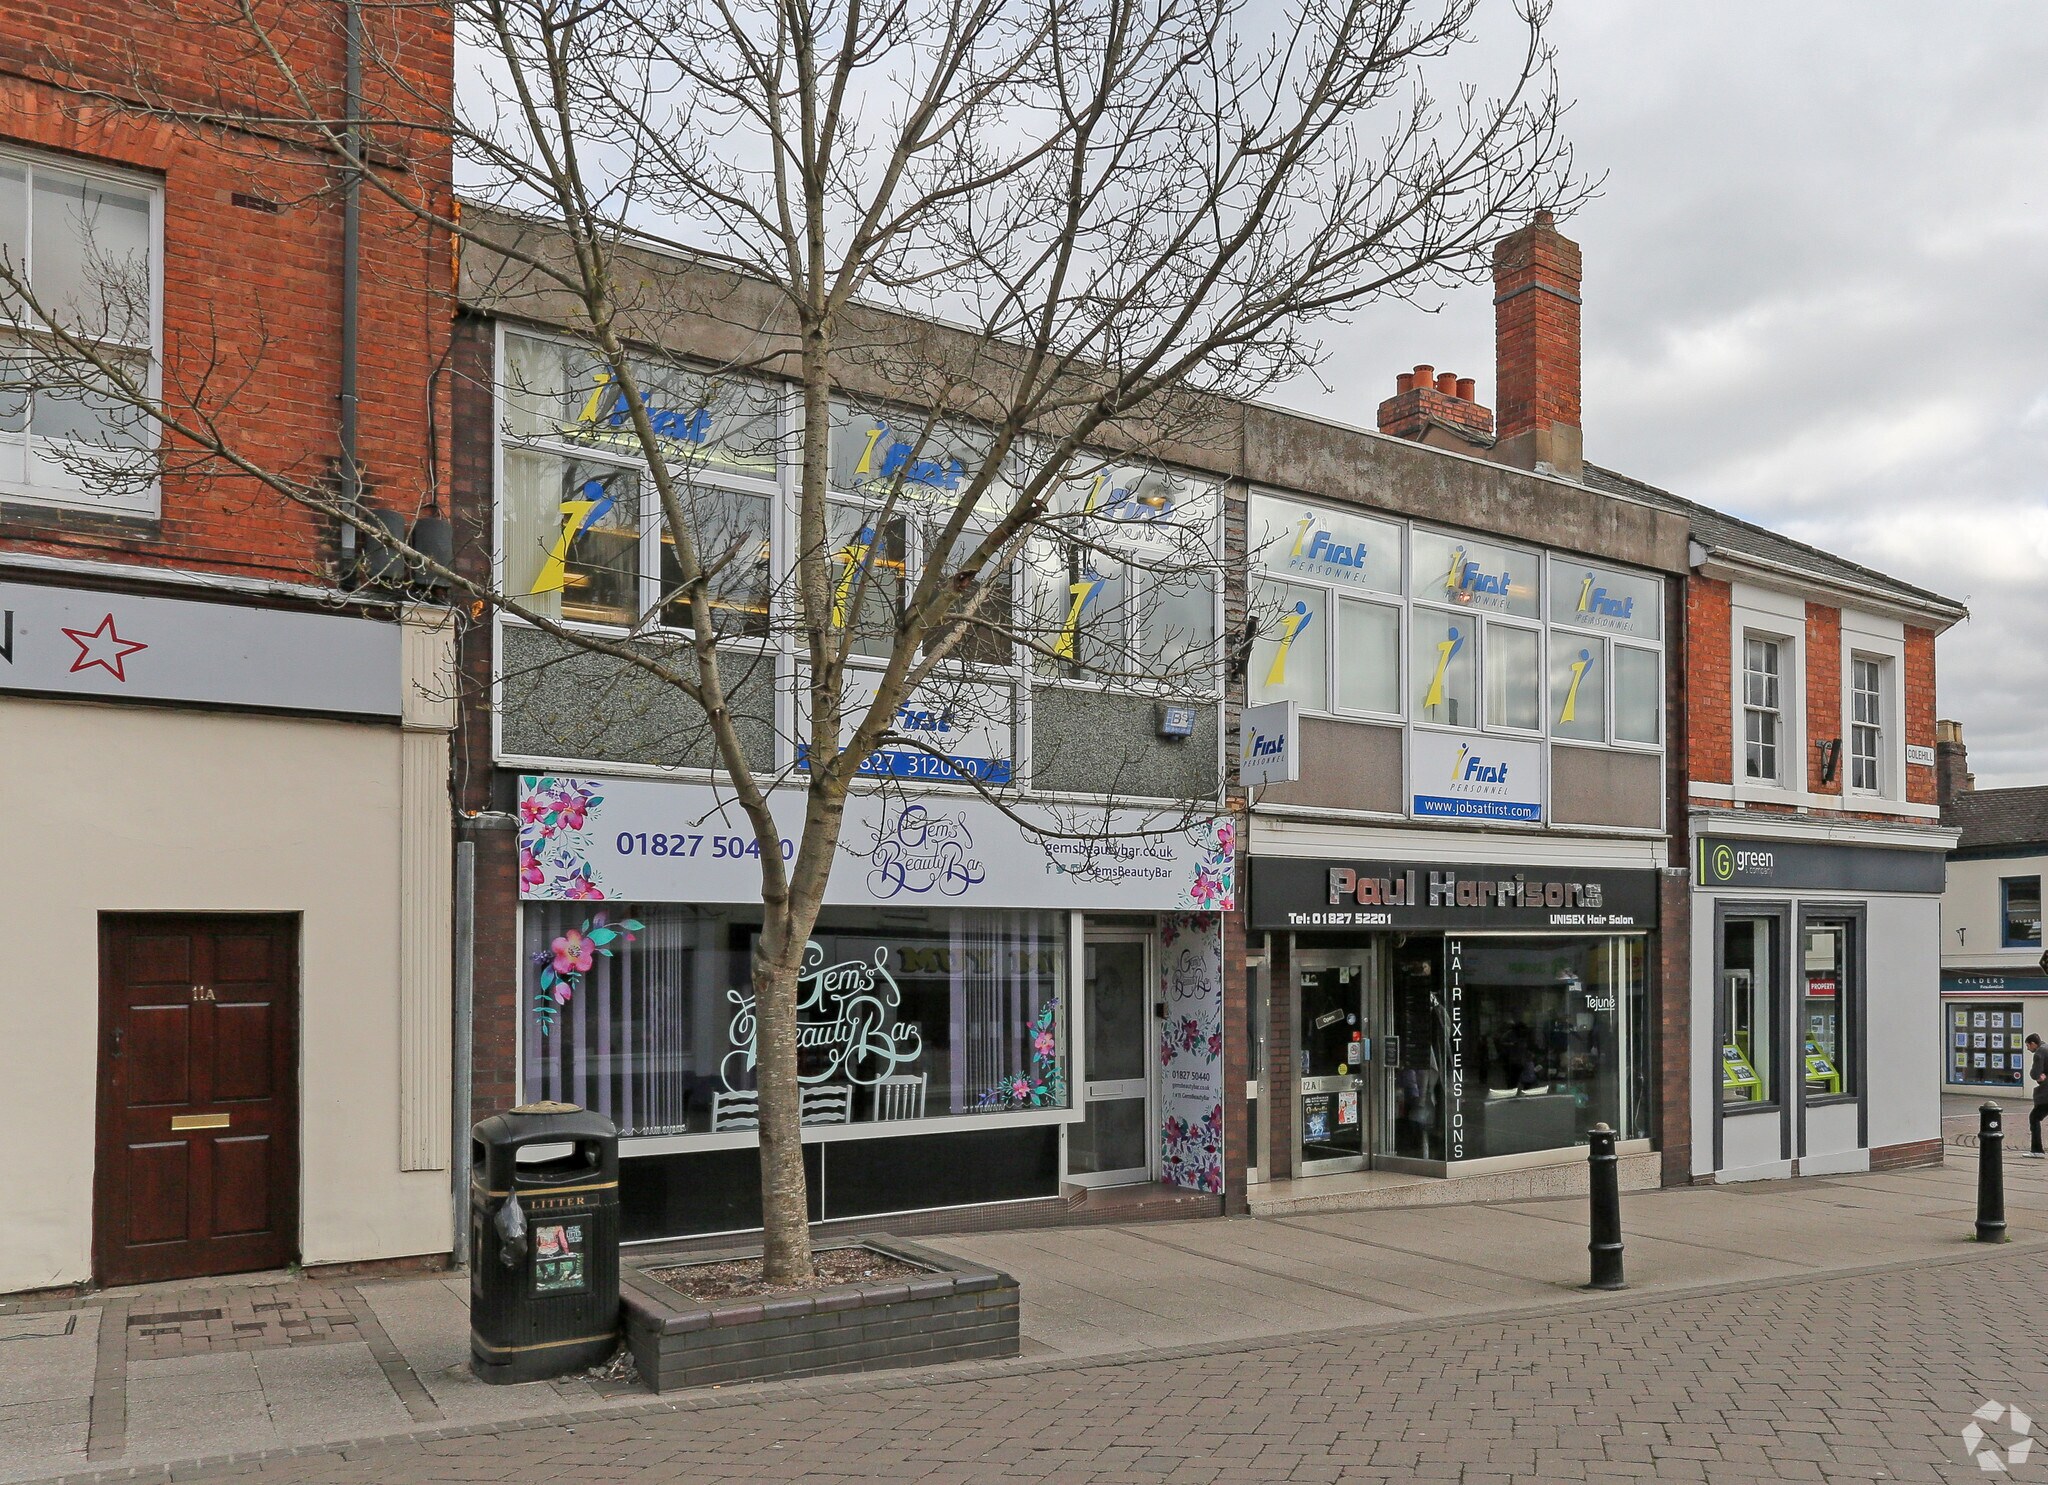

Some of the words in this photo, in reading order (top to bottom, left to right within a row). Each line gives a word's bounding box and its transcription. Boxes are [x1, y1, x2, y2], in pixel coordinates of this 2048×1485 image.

[1308, 530, 1368, 568] First
[1289, 559, 1368, 583] PERSONNEL
[1460, 562, 1512, 596] First
[1589, 588, 1634, 619] First
[1575, 613, 1634, 631] PERSONNEL
[1252, 734, 1285, 757] First
[907, 755, 978, 778] 312000
[1242, 755, 1285, 768] PERSONNEL
[1464, 756, 1508, 783] First
[1450, 783, 1509, 796] PERSONNEL
[1424, 799, 1532, 818] www.jobsatfirst.com
[616, 831, 704, 858] 01827
[711, 836, 795, 861] 5040
[938, 841, 985, 897] Bar
[1736, 850, 1774, 871] green
[1328, 867, 1416, 906] Paul
[1429, 870, 1603, 908] Harrisons
[1288, 912, 1311, 925] Tel:
[1312, 912, 1352, 925] 01827
[1355, 913, 1392, 925] 52201
[1550, 914, 1586, 925] UNISEX
[1587, 914, 1607, 925] Hair
[1608, 914, 1635, 925] Salon
[1450, 941, 1462, 1002] HAIR
[192, 985, 216, 1001] 11A
[844, 995, 922, 1085] Bar
[1172, 1070, 1190, 1080] 01827
[1191, 1071, 1210, 1081] 50440
[1452, 1007, 1463, 1159] EXTENSIONS
[531, 1197, 585, 1209] LITTER
